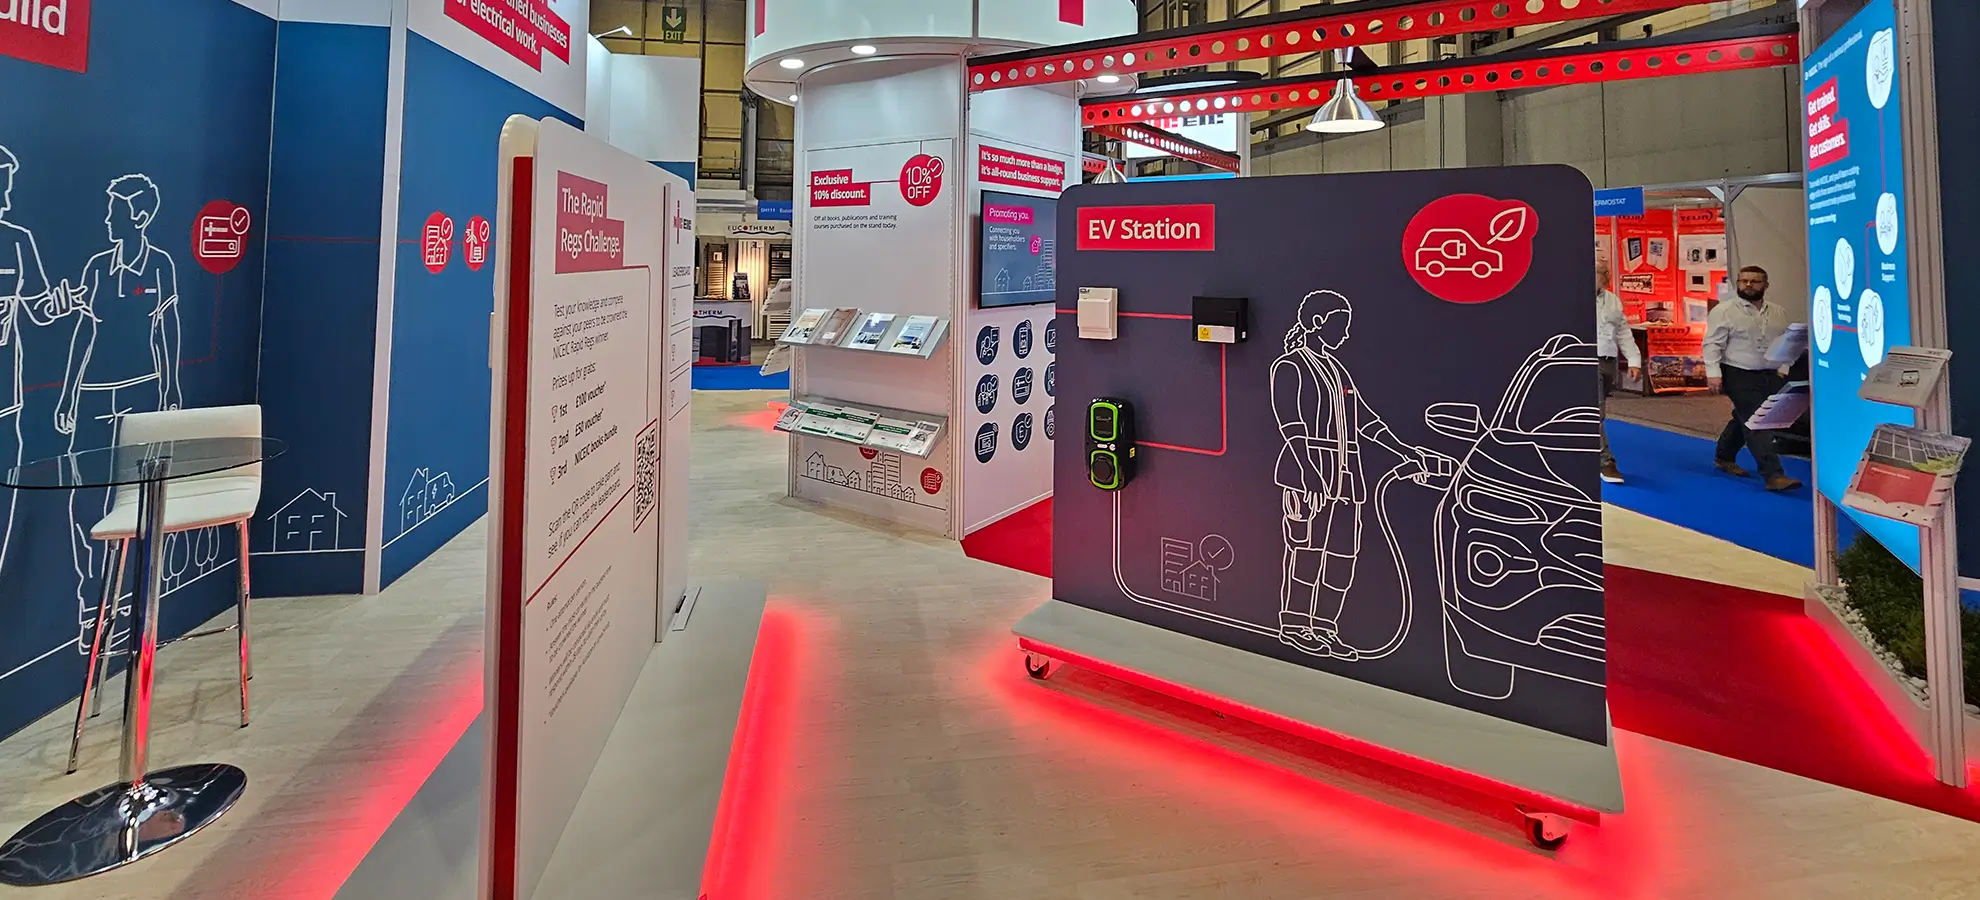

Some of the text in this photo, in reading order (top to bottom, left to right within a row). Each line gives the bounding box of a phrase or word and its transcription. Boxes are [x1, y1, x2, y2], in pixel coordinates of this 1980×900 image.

[470, 0, 539, 54] electrical work.
[530, 3, 567, 48] businesses
[666, 31, 681, 40] EXIT
[1808, 101, 1817, 116] Get
[1809, 122, 1818, 137] Get
[1810, 144, 1818, 159] Get
[981, 150, 991, 160] It's
[992, 154, 999, 162] so
[999, 155, 1015, 166] much
[1016, 158, 1030, 168] more
[1031, 160, 1043, 170] than
[814, 174, 848, 186] Exclusive
[906, 166, 931, 185] 10%
[991, 167, 1017, 179] all-round
[1017, 171, 1040, 183] business
[814, 189, 867, 200] 10% discount.
[907, 186, 931, 199] OFF
[562, 187, 604, 223] The Rapid
[841, 214, 868, 222] publications
[879, 214, 897, 222] training
[989, 207, 1029, 221] Promoting you.
[830, 222, 852, 230] purchased
[989, 226, 1012, 235] Connecting
[1089, 218, 1200, 239] EV Station
[561, 227, 621, 259] Regs Challenge.
[564, 303, 576, 319] your
[577, 297, 599, 312] knowledge
[571, 321, 582, 337] your
[558, 429, 569, 448] 2nd
[558, 460, 567, 479] 3rd
